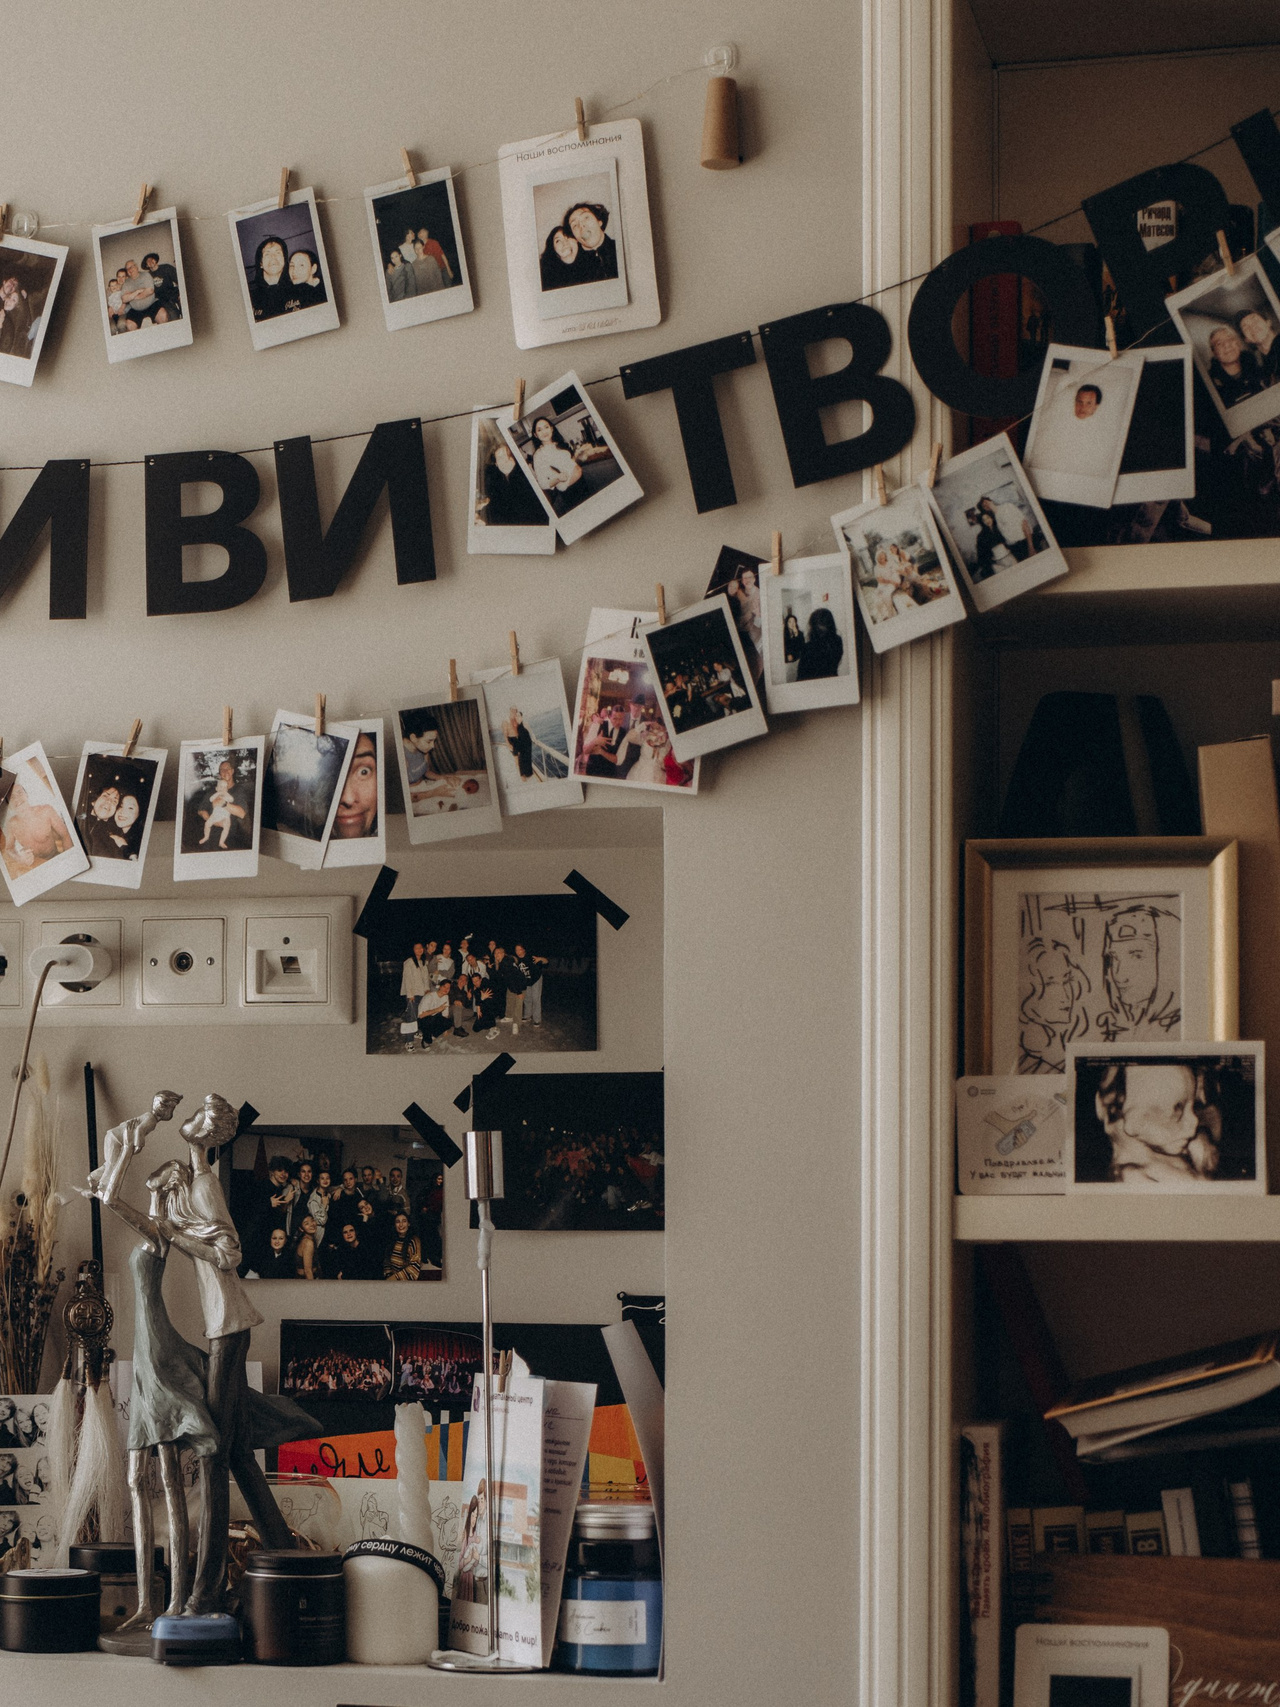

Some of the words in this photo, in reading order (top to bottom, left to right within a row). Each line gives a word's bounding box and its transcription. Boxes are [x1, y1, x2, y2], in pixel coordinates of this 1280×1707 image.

[515, 150, 545, 163] Наши
[546, 133, 623, 157] воспоминания
[360, 1540, 399, 1554] сердцу
[399, 1546, 433, 1566] лежит
